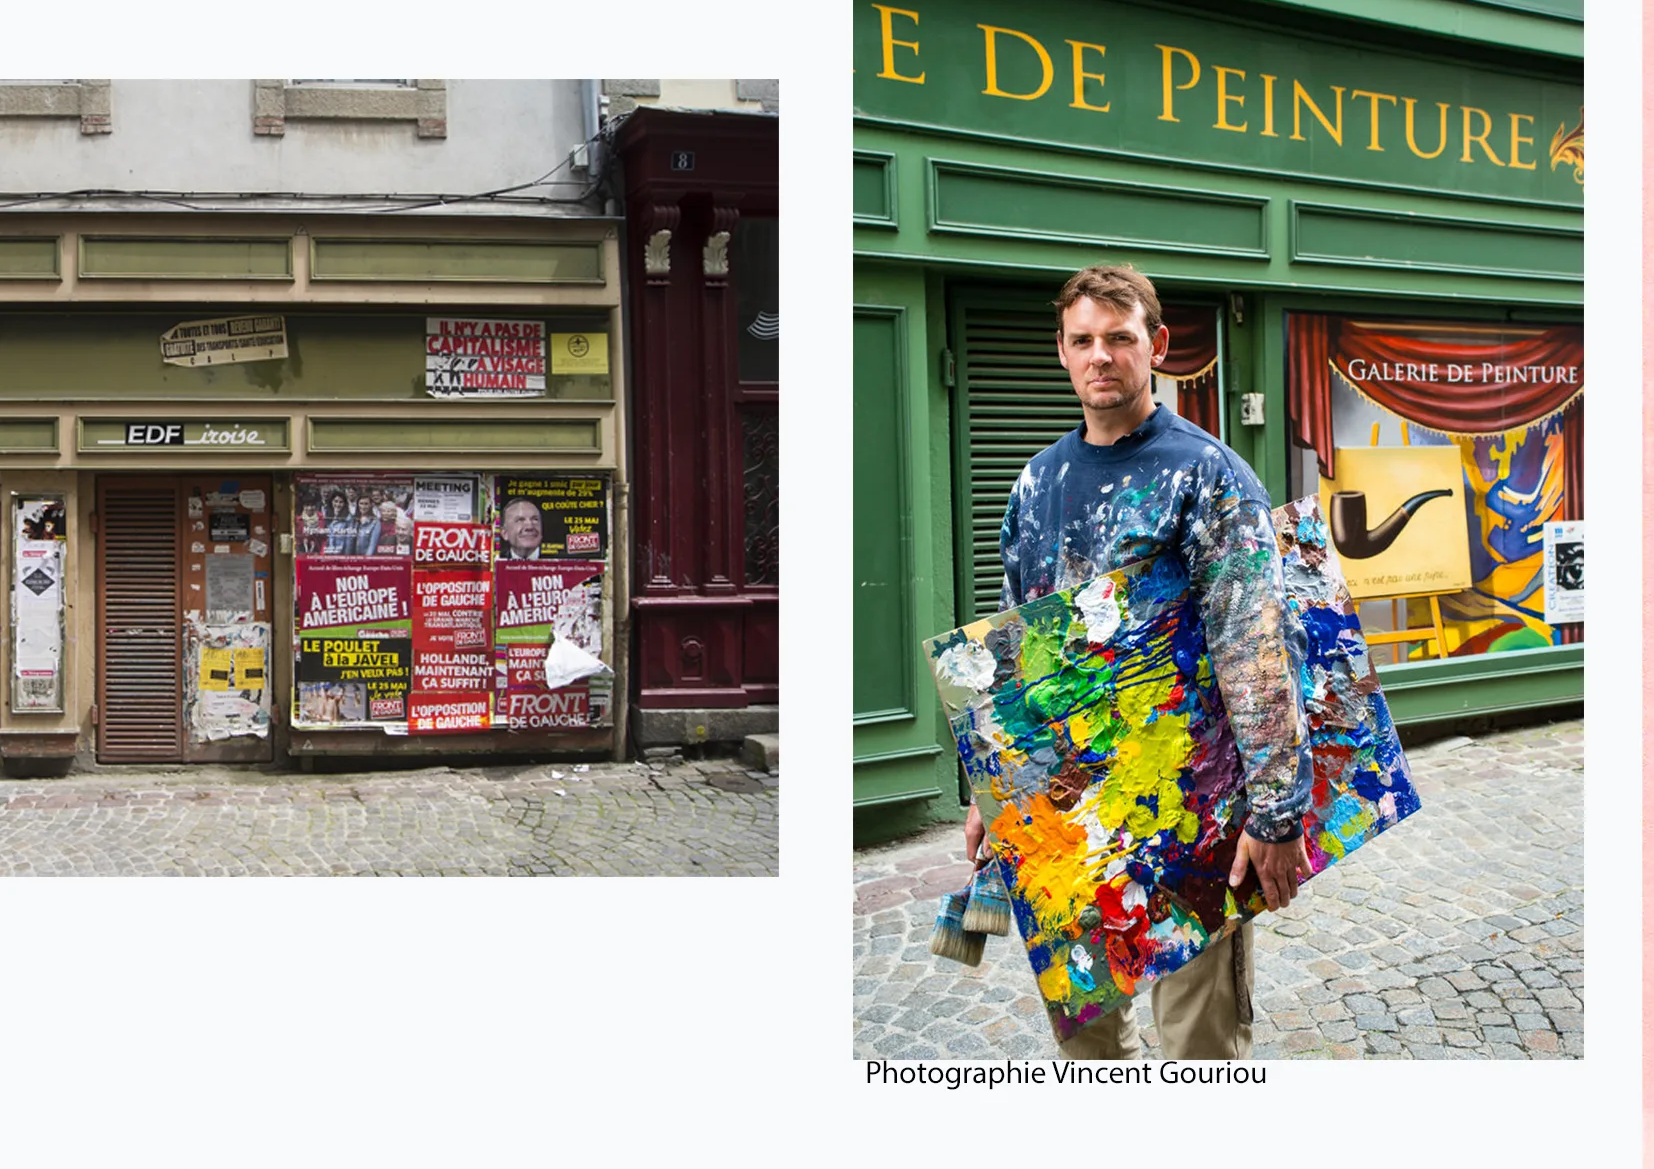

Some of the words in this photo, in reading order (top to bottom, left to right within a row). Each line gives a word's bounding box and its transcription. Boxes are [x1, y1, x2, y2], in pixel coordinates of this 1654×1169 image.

[853, 3, 926, 84] E
[976, 23, 1111, 113] DE
[678, 152, 688, 169] 8
[440, 321, 450, 335] IL
[454, 322, 478, 335] N'Y
[481, 322, 493, 336] A
[495, 323, 521, 337] PAS
[523, 324, 541, 337] DE
[428, 336, 541, 356] CAPITALISME
[489, 358, 544, 373] VISAGE
[1447, 363, 1473, 383] DE
[463, 373, 527, 389] HUMAIN
[128, 425, 181, 444] EDF
[200, 424, 262, 444] iroise
[415, 482, 471, 493] MEETING
[566, 489, 576, 497] de
[542, 501, 554, 510] QUI
[579, 501, 598, 509] CHER
[417, 527, 491, 549] FRONT
[415, 549, 434, 561] DE
[436, 549, 490, 563] GAUCHE
[335, 574, 369, 592] NON
[416, 581, 490, 594] L'OPPOSITION
[531, 574, 564, 591] NON
[310, 591, 322, 611] À
[325, 587, 398, 609] L'EUROPE
[422, 595, 438, 607] DE
[440, 594, 485, 607] GAUCHE
[507, 591, 519, 610] À
[303, 640, 321, 652] LE
[323, 640, 380, 652] POULET
[325, 653, 334, 665] à
[337, 654, 350, 665] la
[353, 654, 398, 665] JAVEL
[420, 653, 489, 666] HOLLANDE,
[360, 668, 384, 678] VEUX
[386, 667, 404, 676] PAS
[415, 665, 494, 676] MAINTENANT
[516, 671, 531, 682] ÇA
[367, 682, 377, 690] LE
[378, 682, 389, 690] 25
[390, 682, 407, 690] MAI
[422, 677, 438, 689] ÇA
[440, 678, 481, 689] SUFFIT
[411, 701, 487, 717] L'OPPOSITION
[510, 693, 586, 714] FRONT
[417, 718, 434, 729] DE
[436, 715, 481, 729] GAUCHE
[510, 716, 527, 729] DE
[529, 713, 586, 728] GAUCHE
